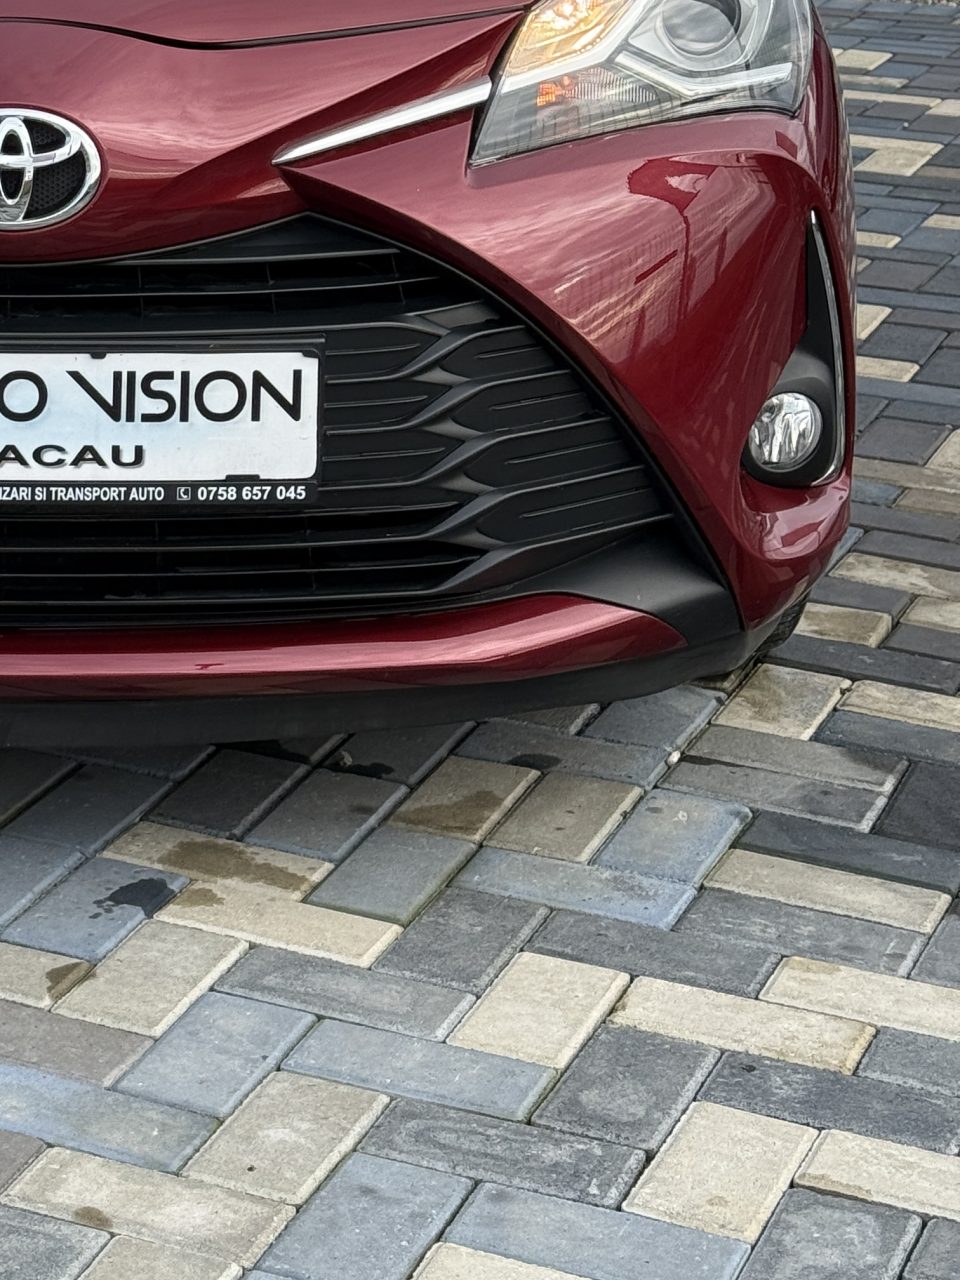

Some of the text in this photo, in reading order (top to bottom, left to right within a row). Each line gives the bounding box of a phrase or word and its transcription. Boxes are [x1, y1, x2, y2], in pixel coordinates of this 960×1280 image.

[66, 369, 302, 423] VISION
[34, 486, 47, 501] SI
[49, 486, 127, 501] TRANSPORT
[129, 486, 165, 501] AUTO
[197, 486, 237, 501] 0758
[242, 485, 272, 501] 657
[276, 485, 306, 500] 045
